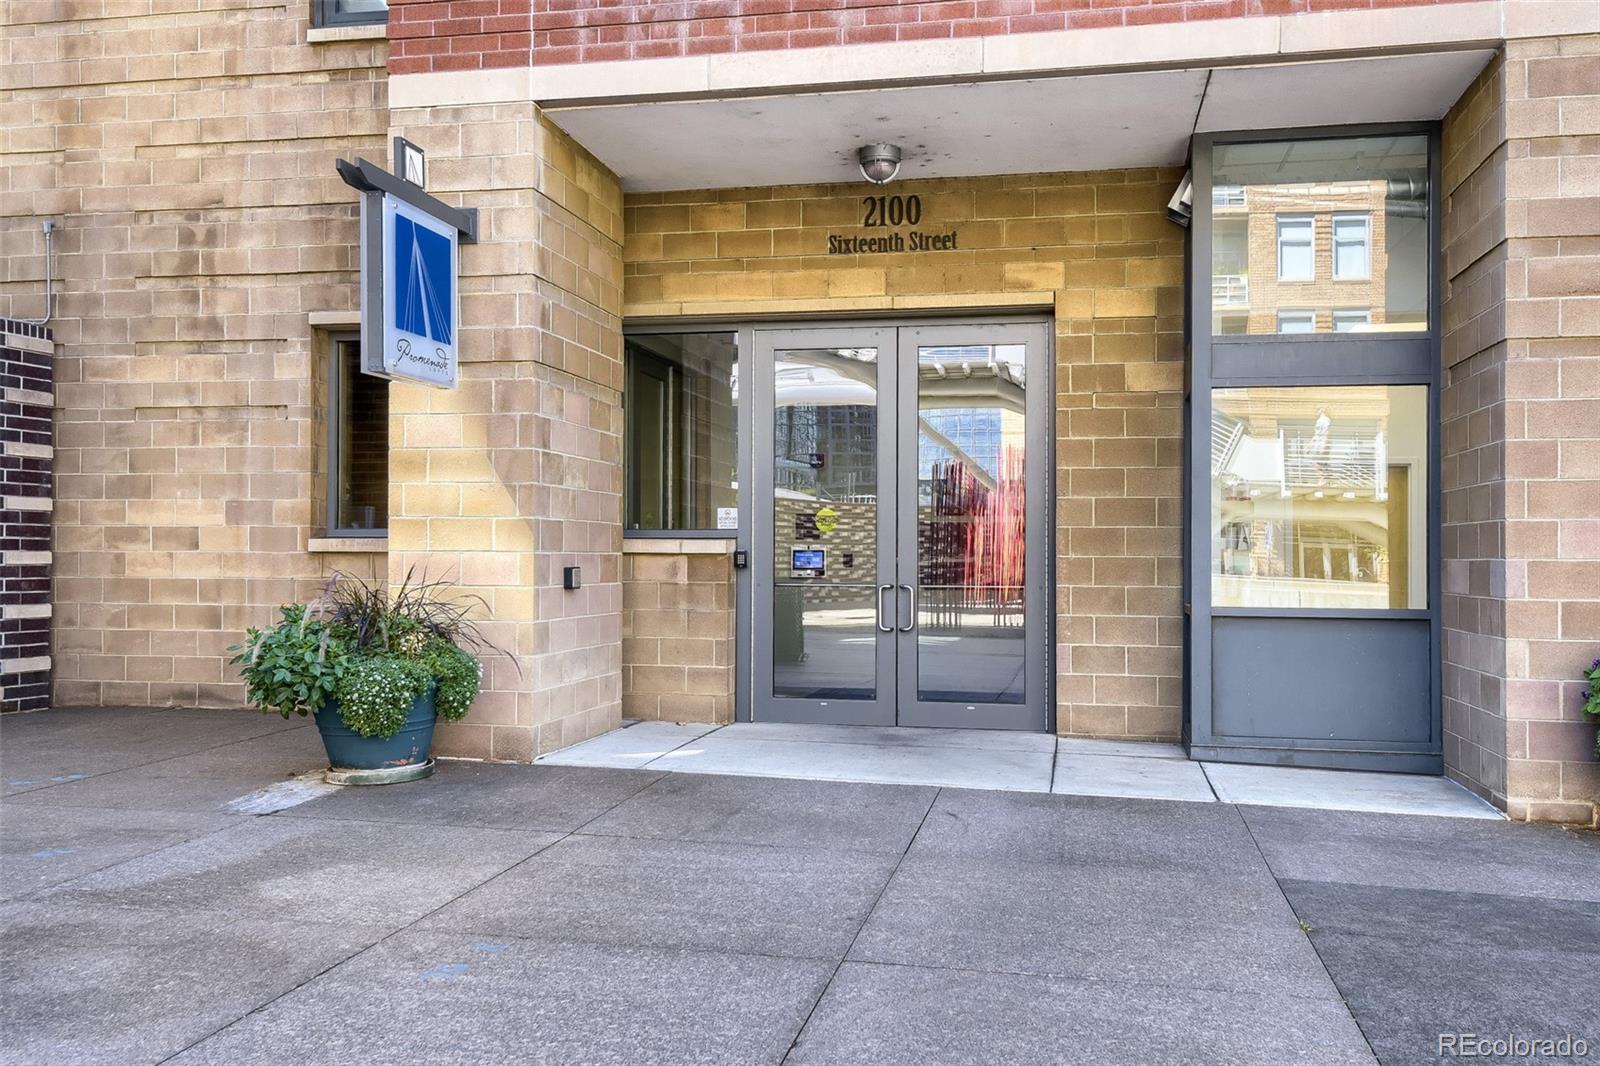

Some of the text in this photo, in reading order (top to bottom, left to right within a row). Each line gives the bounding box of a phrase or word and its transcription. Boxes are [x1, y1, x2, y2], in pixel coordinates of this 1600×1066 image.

[863, 195, 921, 227] 2100
[829, 231, 957, 254] Sixteenth Street
[397, 338, 449, 369] Promenade
